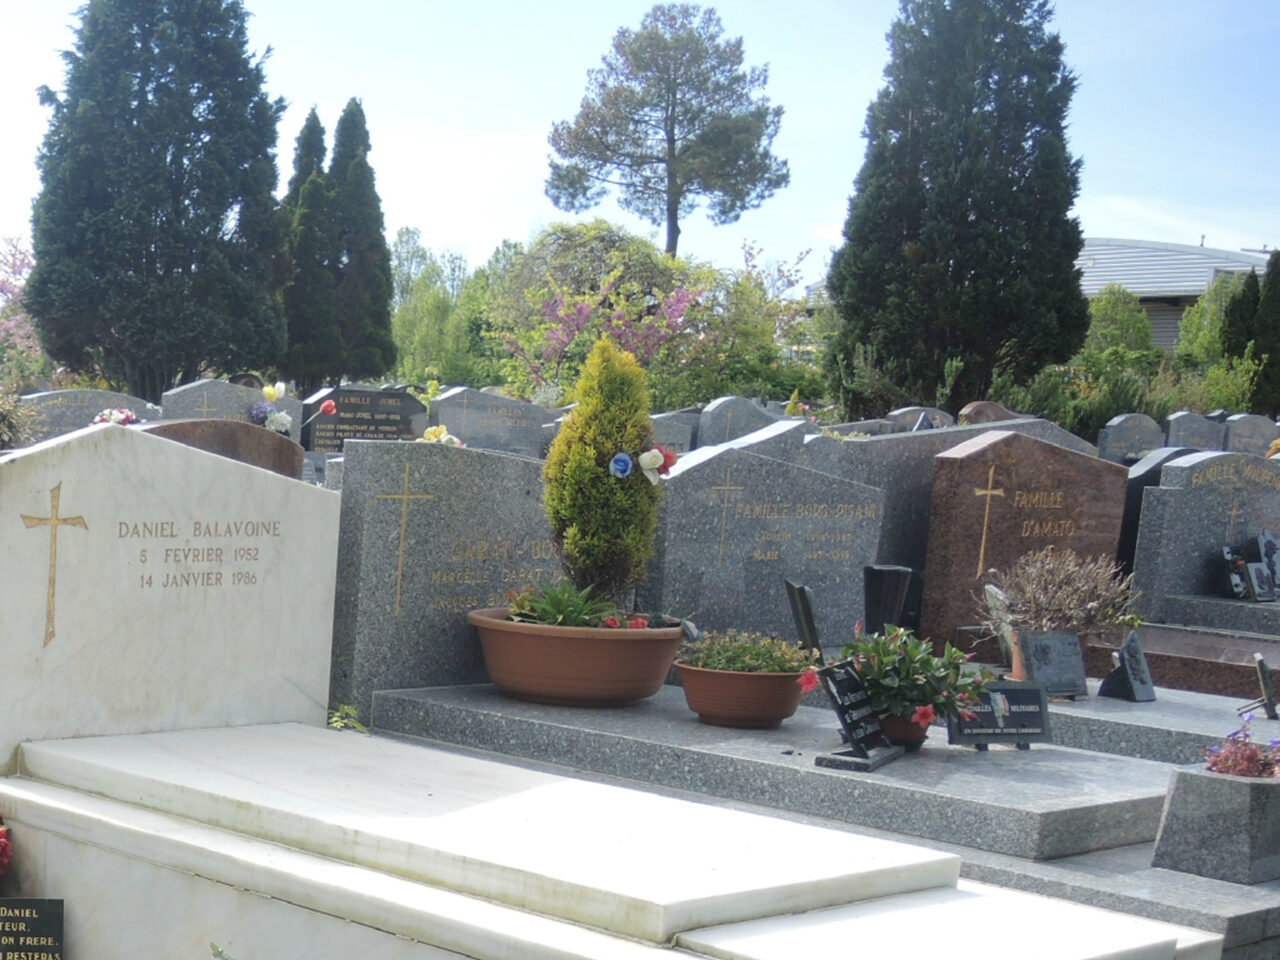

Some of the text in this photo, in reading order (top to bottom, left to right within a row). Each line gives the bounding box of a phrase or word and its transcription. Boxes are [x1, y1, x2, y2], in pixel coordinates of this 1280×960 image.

[1014, 491, 1064, 508] FAMILLE
[735, 503, 792, 518] FAMILLE
[118, 521, 281, 538] DANIEL BALAVOINE
[1022, 520, 1075, 537] D'AMATO
[140, 548, 259, 563] 5 FEVRIER 1952
[450, 540, 512, 561] GARAT
[140, 572, 257, 588] 14 JANVIER 1986
[501, 568, 543, 582] GARAT
[0, 906, 38, 918] DANIEL
